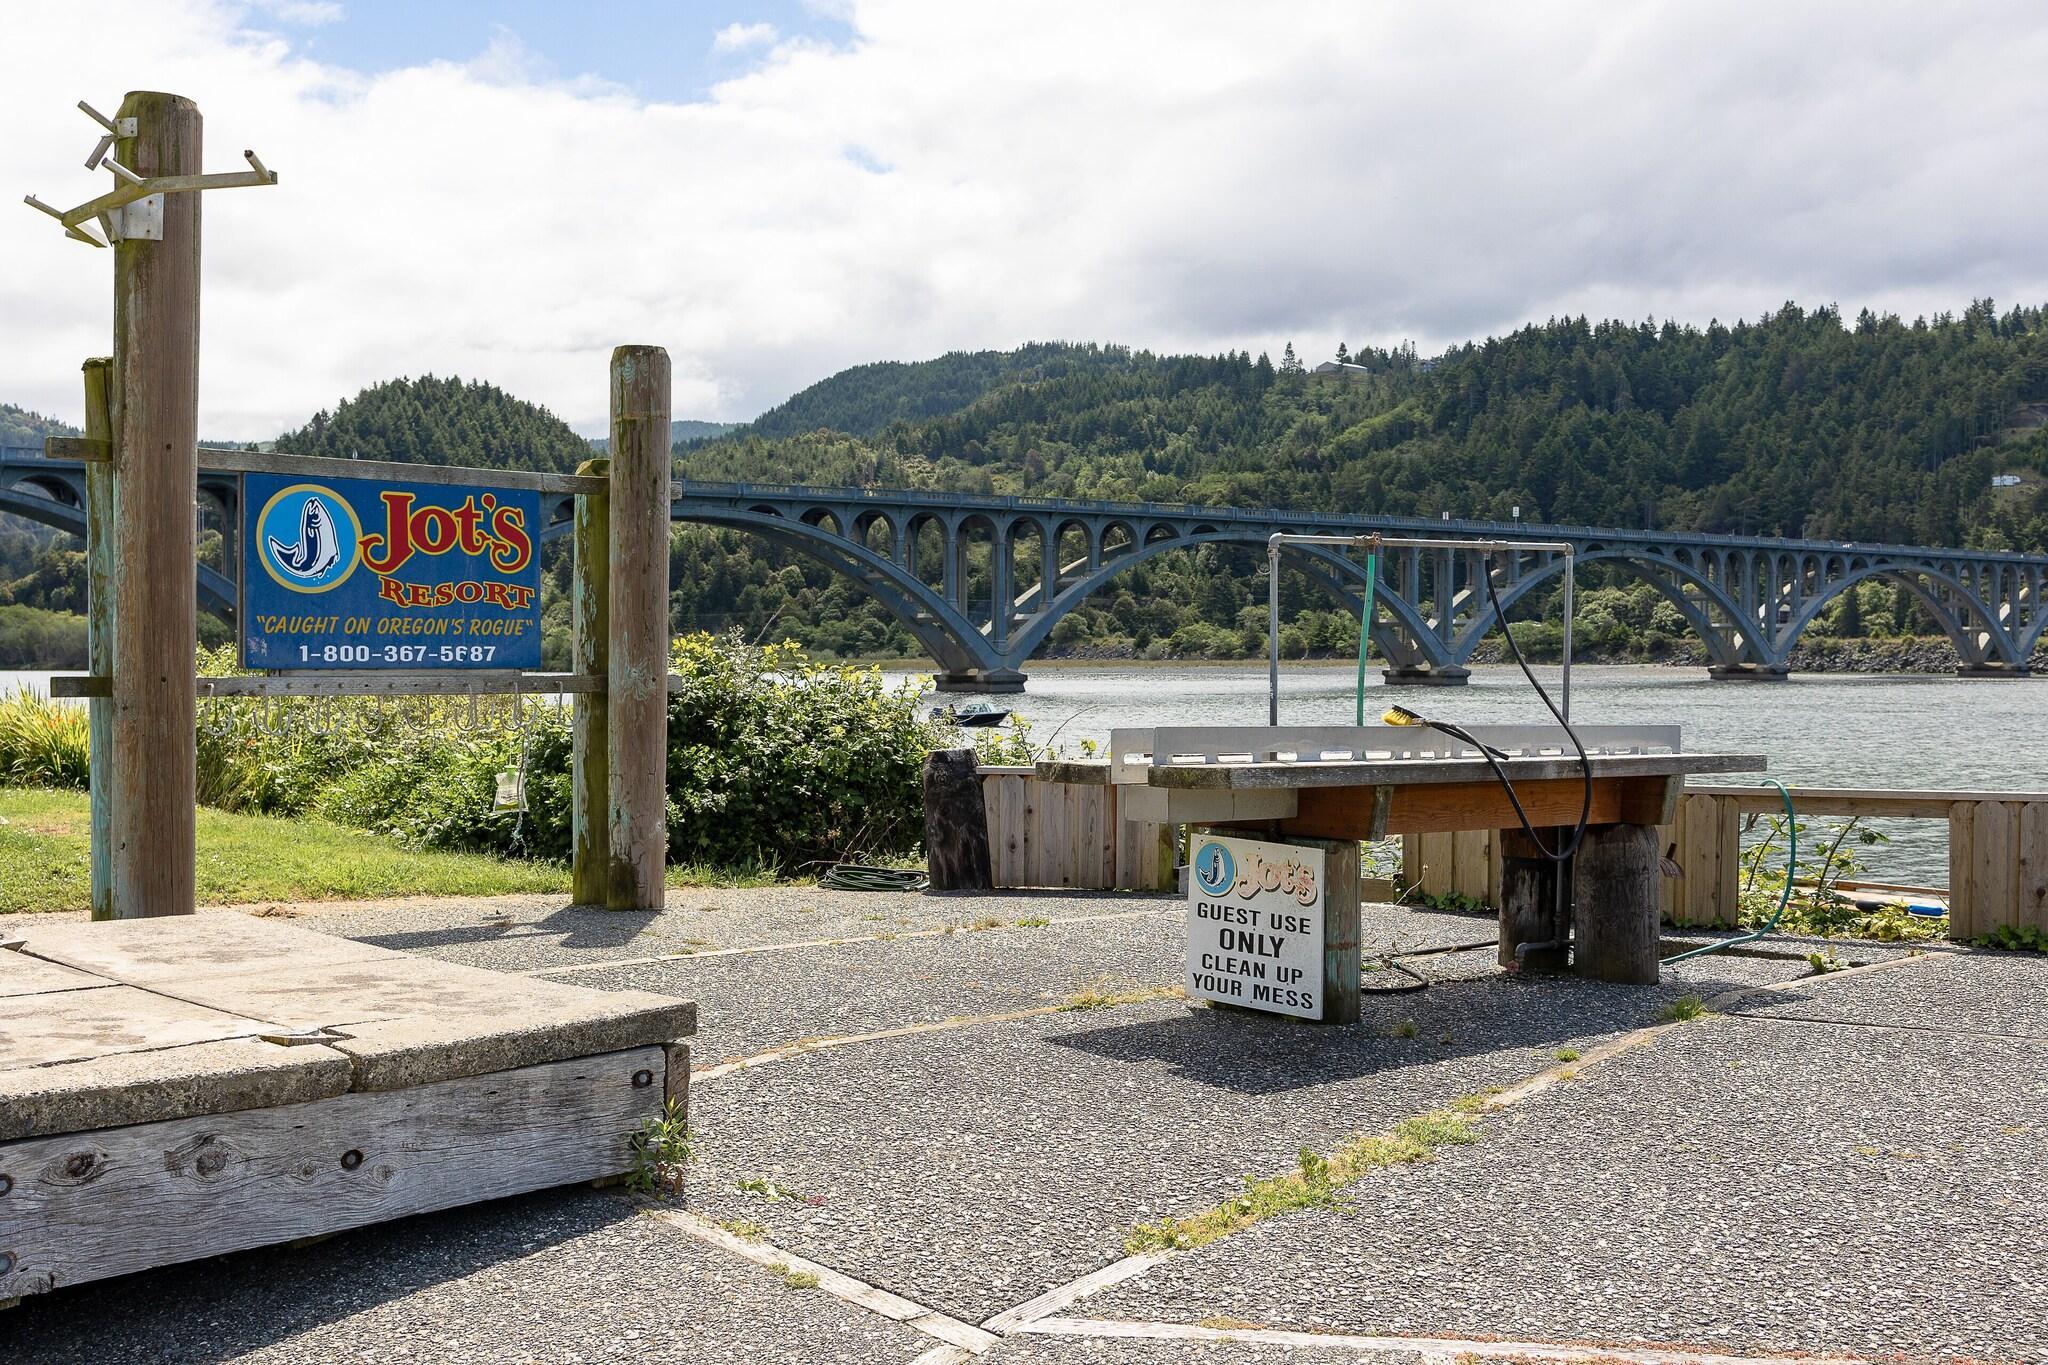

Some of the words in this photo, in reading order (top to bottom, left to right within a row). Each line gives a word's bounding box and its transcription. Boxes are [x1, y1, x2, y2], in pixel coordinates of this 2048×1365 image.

[358, 491, 532, 575] Jot's
[378, 575, 534, 609] RESORT
[344, 616, 371, 634] ON
[377, 617, 464, 635] OREGON'S
[1237, 853, 1317, 906] GUEST
[1270, 913, 1311, 935] USE
[1219, 928, 1285, 958] ONLY
[1201, 953, 1266, 979] CLEAN
[1276, 966, 1303, 985] UP
[1192, 972, 1242, 997] YOUR
[1253, 984, 1313, 1009] MESS
